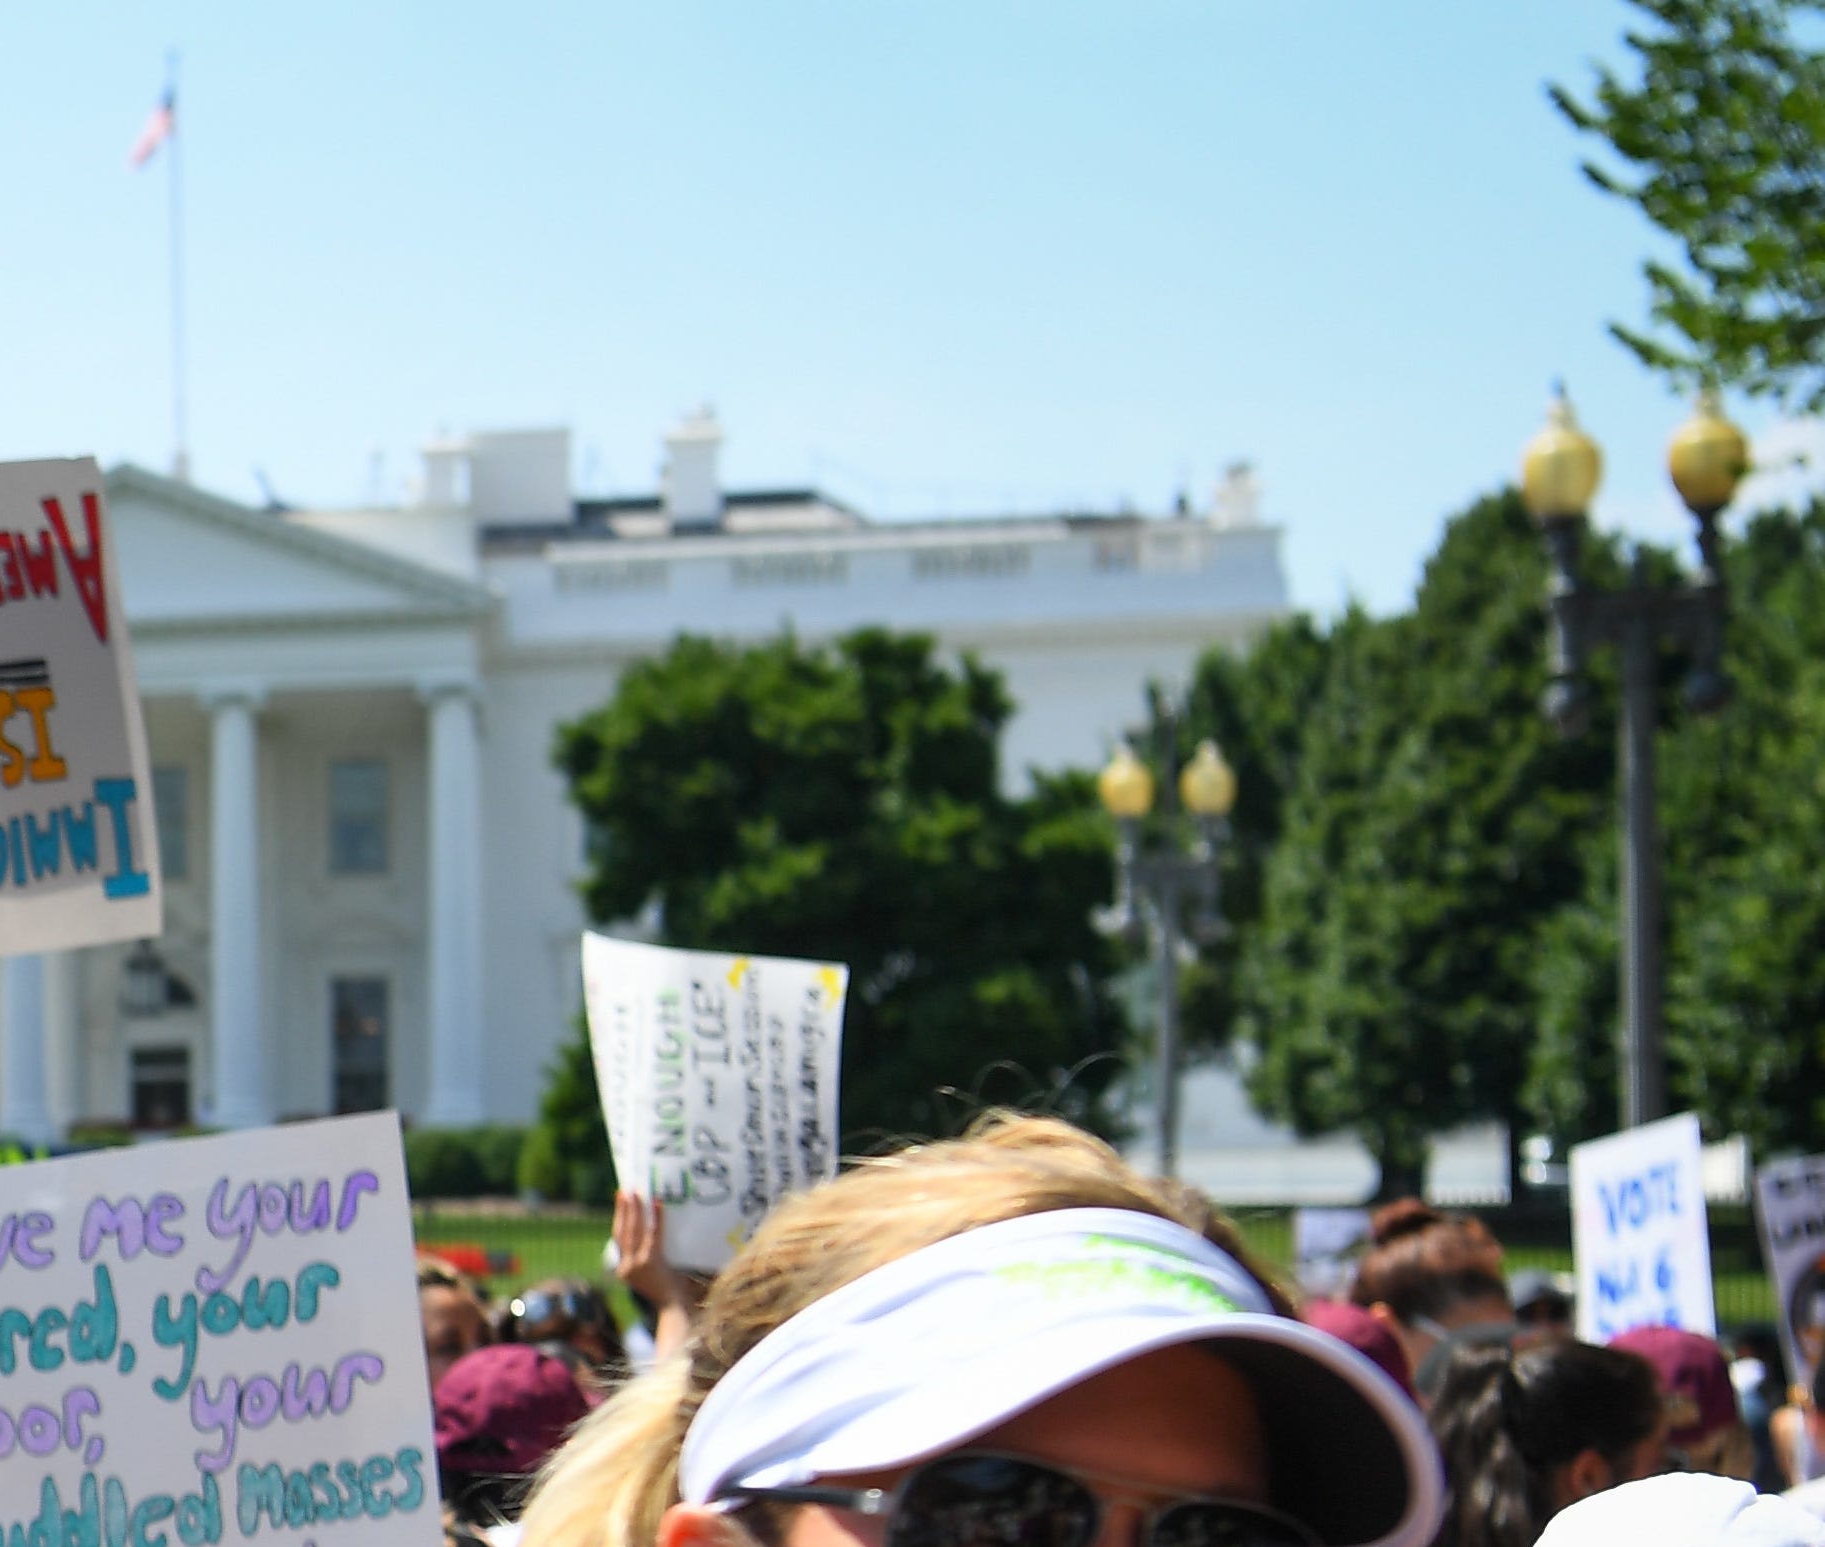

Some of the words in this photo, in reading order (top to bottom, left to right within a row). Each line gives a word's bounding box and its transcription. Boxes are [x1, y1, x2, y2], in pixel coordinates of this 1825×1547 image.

[197, 1170, 379, 1295] your
[152, 1261, 340, 1399] your
[191, 1352, 385, 1473] your
